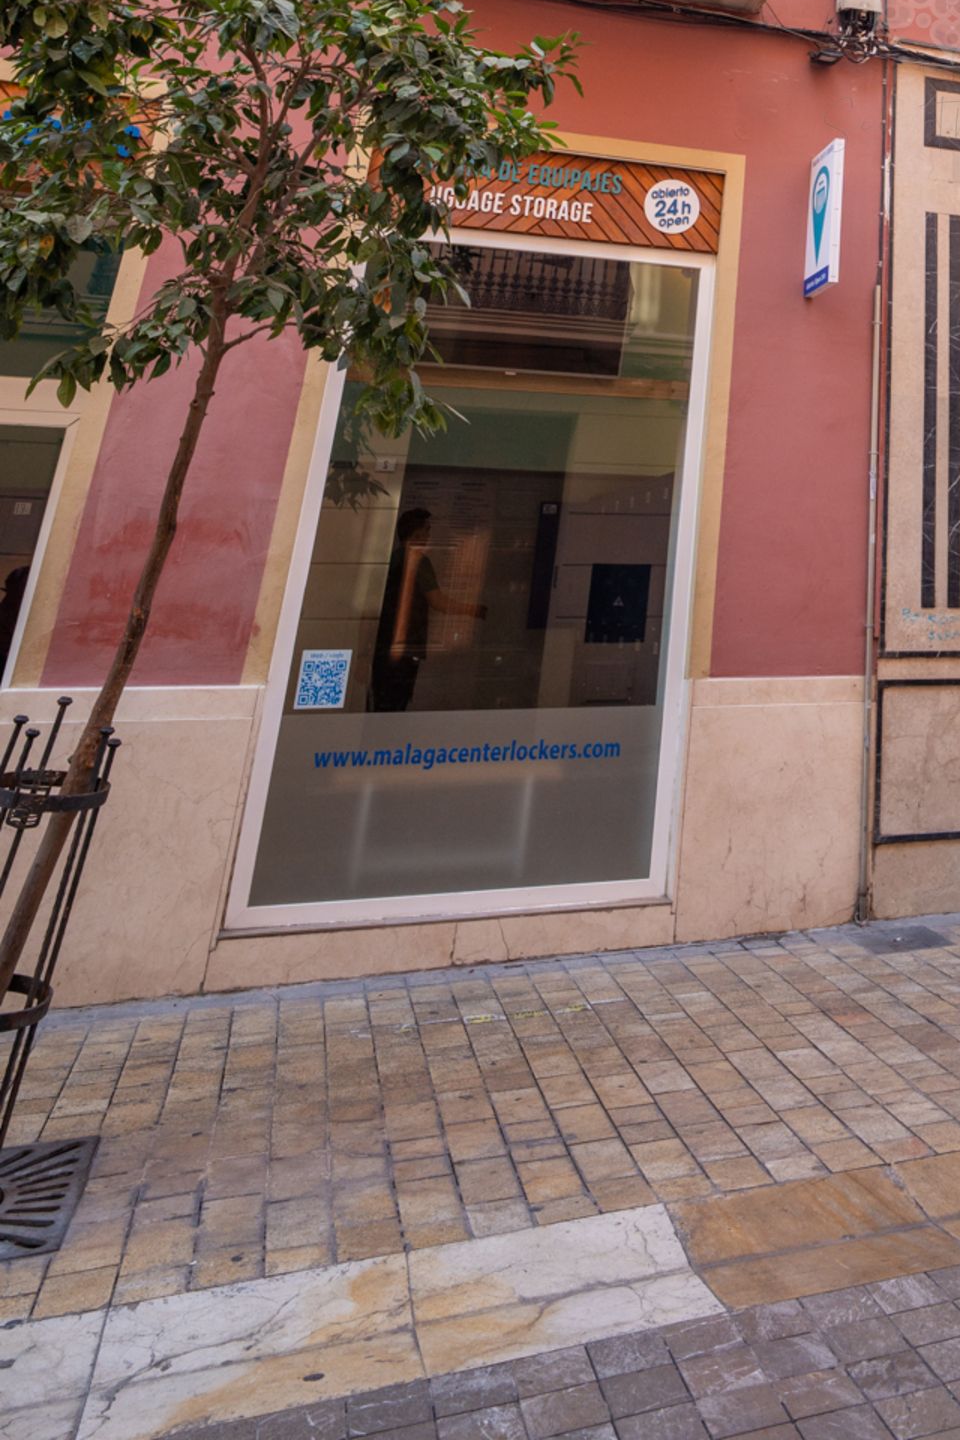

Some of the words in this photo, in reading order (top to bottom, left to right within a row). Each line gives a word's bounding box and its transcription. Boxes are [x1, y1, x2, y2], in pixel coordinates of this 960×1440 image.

[499, 160, 523, 183] DE
[527, 164, 624, 194] EQUIPAJES
[651, 186, 690, 200] abierto
[510, 194, 594, 223] STORAGE
[659, 216, 689, 229] open
[314, 738, 621, 770] www.malagacenterlockers.com
